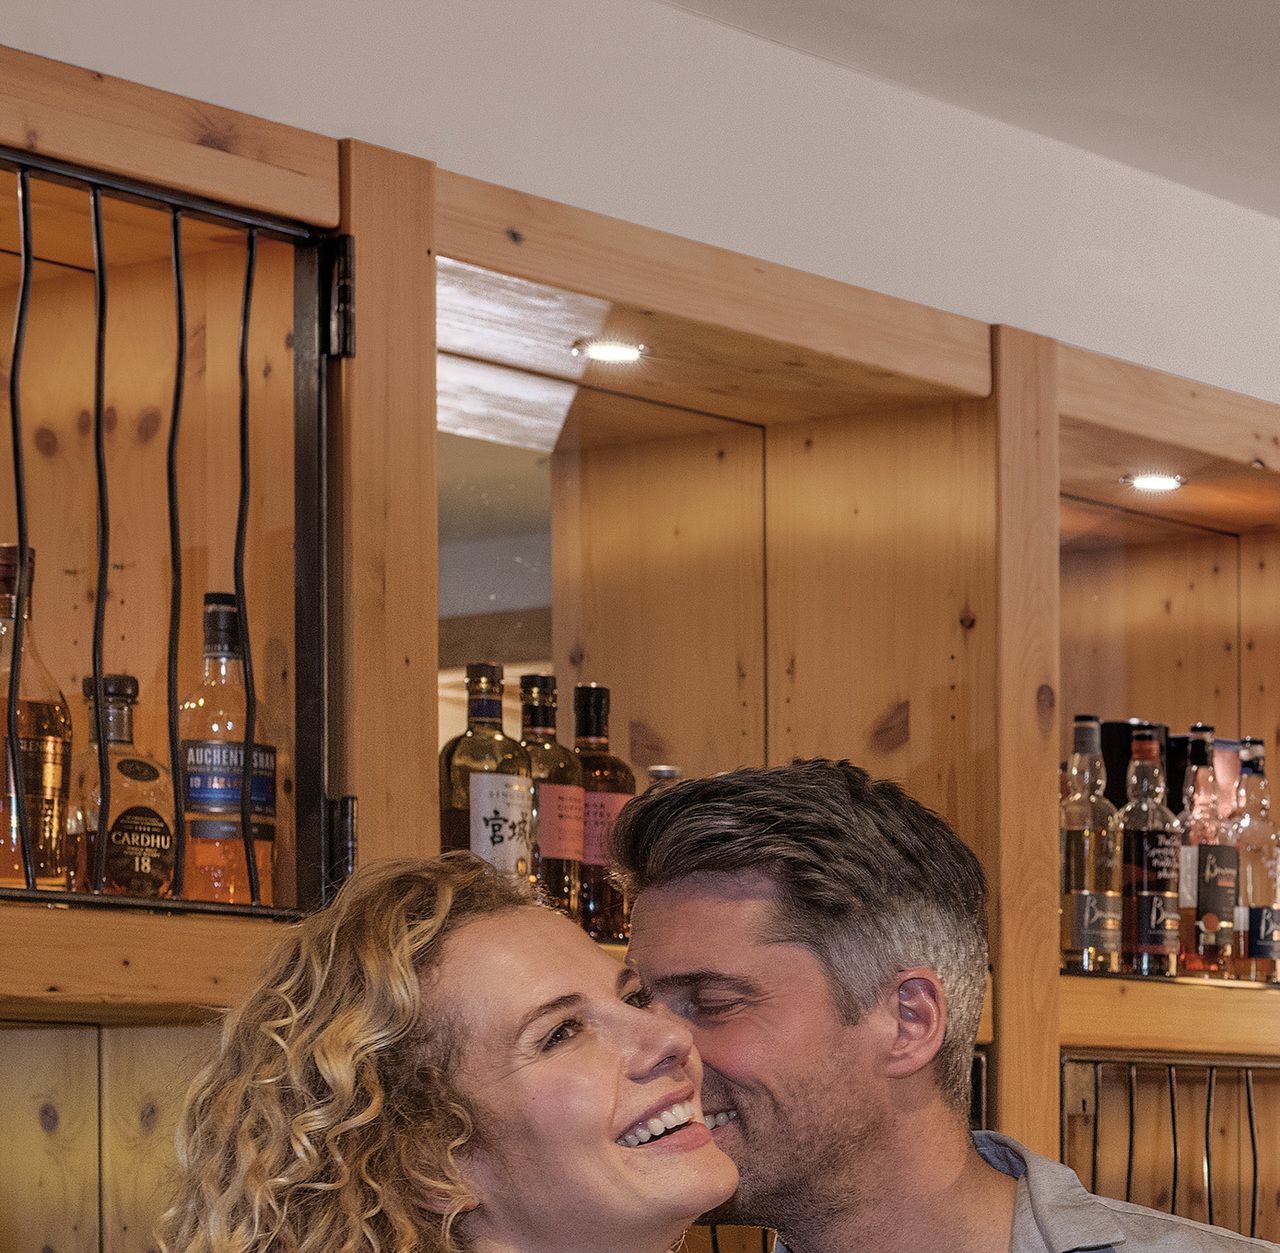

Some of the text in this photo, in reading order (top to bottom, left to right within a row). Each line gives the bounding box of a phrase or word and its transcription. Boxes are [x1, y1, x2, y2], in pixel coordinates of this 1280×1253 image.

[187, 746, 276, 770] AUCHENTSHAN
[111, 831, 171, 850] CARDHU
[134, 856, 151, 873] 18
